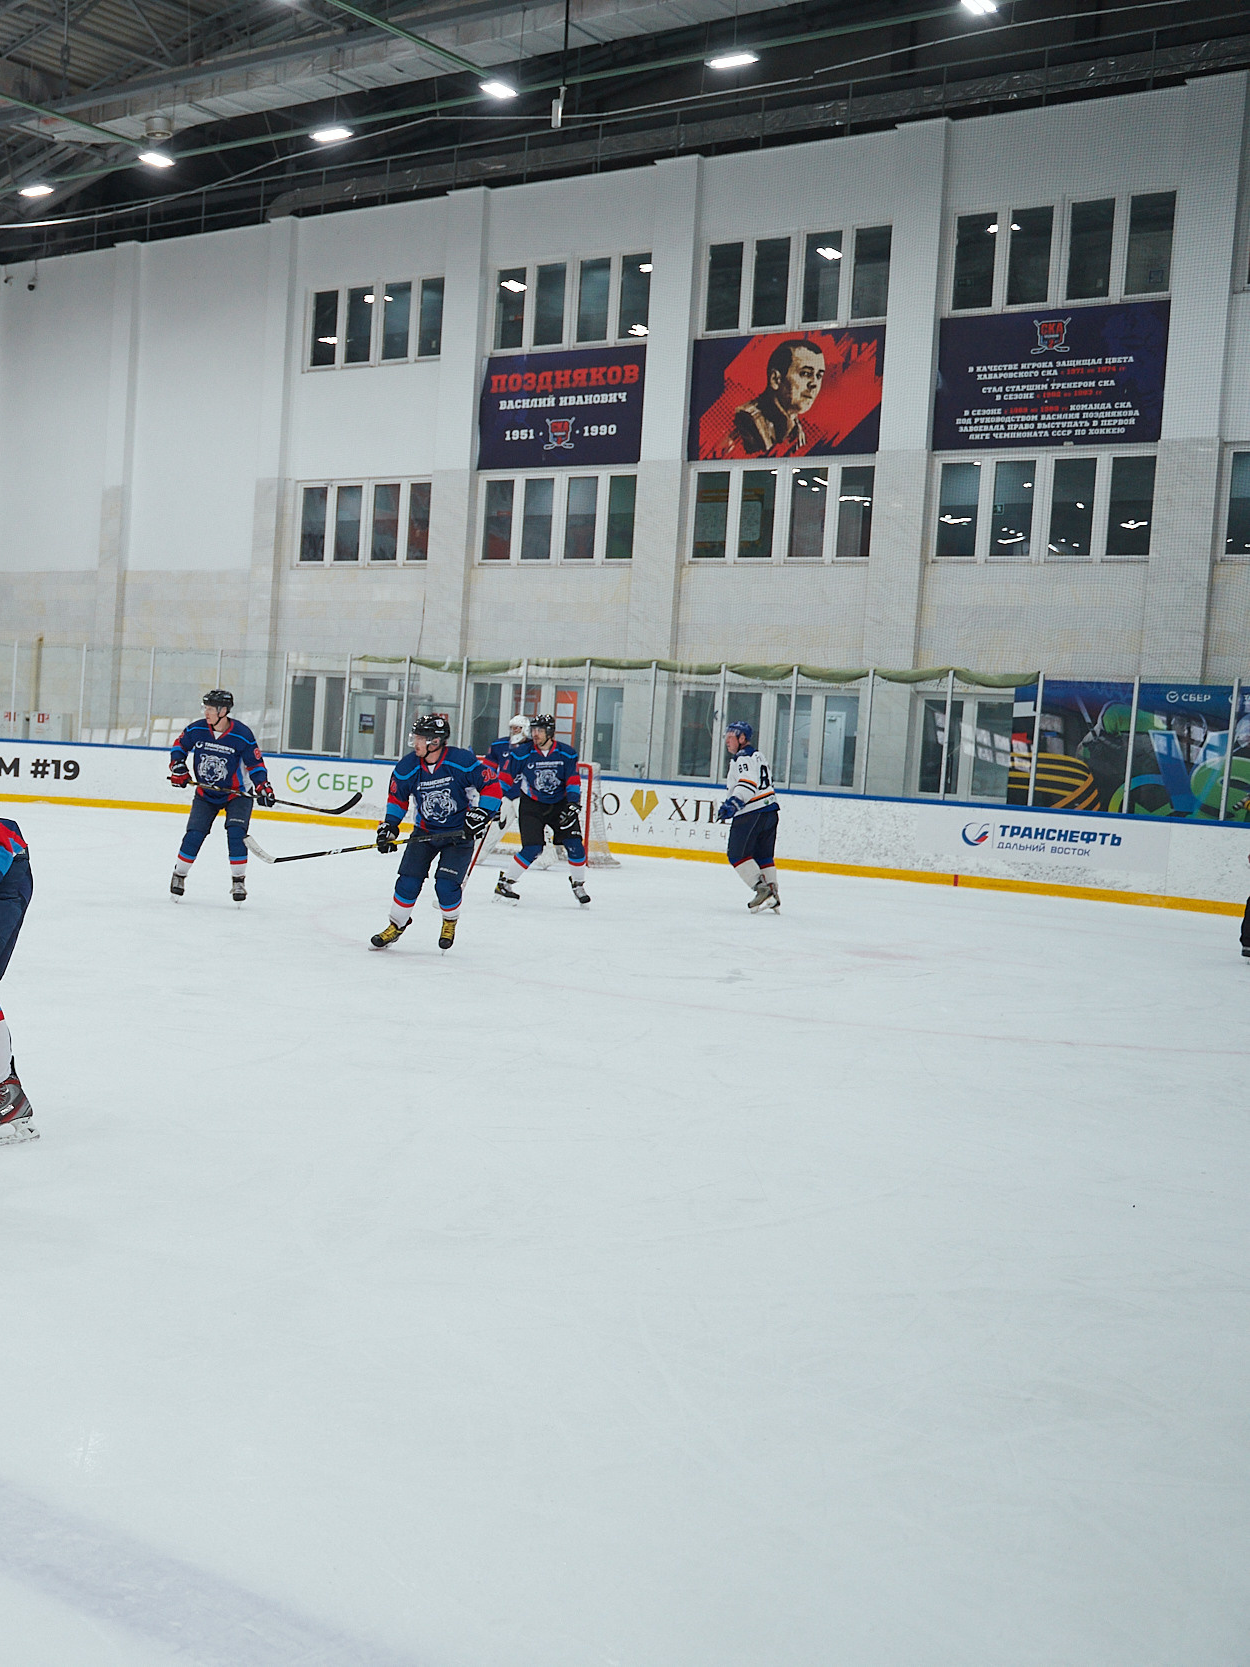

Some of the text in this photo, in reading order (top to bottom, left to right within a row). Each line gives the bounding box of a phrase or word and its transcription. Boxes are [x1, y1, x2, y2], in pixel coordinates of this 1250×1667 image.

[976, 363, 1019, 372] КАЧЕСТВЕ
[1021, 361, 1054, 370] ИГРОКА
[1056, 358, 1103, 368] ЗАЩИЩАЛ
[1105, 356, 1134, 364] ЦВЕТА
[490, 364, 640, 393] ПОЗДНЯКОВ
[977, 370, 1039, 380] ХАБАРОВСКОГО
[1005, 384, 1048, 393] СТАРШИМ
[1051, 381, 1095, 390] ТРЕНЕРОМ
[499, 391, 628, 411] ВАСИЛИЙ ИВАНОВИЧ
[1003, 392, 1034, 400] СЕЗОНЕ
[971, 408, 1002, 416] СЕЗОНЕ
[1070, 402, 1111, 411] КОМАНДА
[974, 415, 1038, 424] РУКОВОДСТВОМ
[1041, 413, 1080, 421] ВАСИЛИЯ
[1082, 410, 1140, 419] ПОЗДНЯКОВА
[583, 424, 617, 437] 1990
[959, 424, 1005, 432] ЗАВОЕВАЛА
[1037, 421, 1090, 429] ВЫСТУПАТЬ
[1100, 418, 1135, 426] ПЕРВОЙ
[504, 428, 535, 442] 1951
[993, 430, 1049, 439] ЧЕМПИОНАТА
[1088, 427, 1126, 436] ХОККЕЮ
[1181, 694, 1211, 703] СБЕР
[30, 758, 80, 781] #19
[317, 773, 373, 793] СБЕР
[999, 824, 1122, 847] ТРАНСНЕФТЬ
[997, 842, 1091, 857] ДАЛЬНИЙ ВОСТОК
